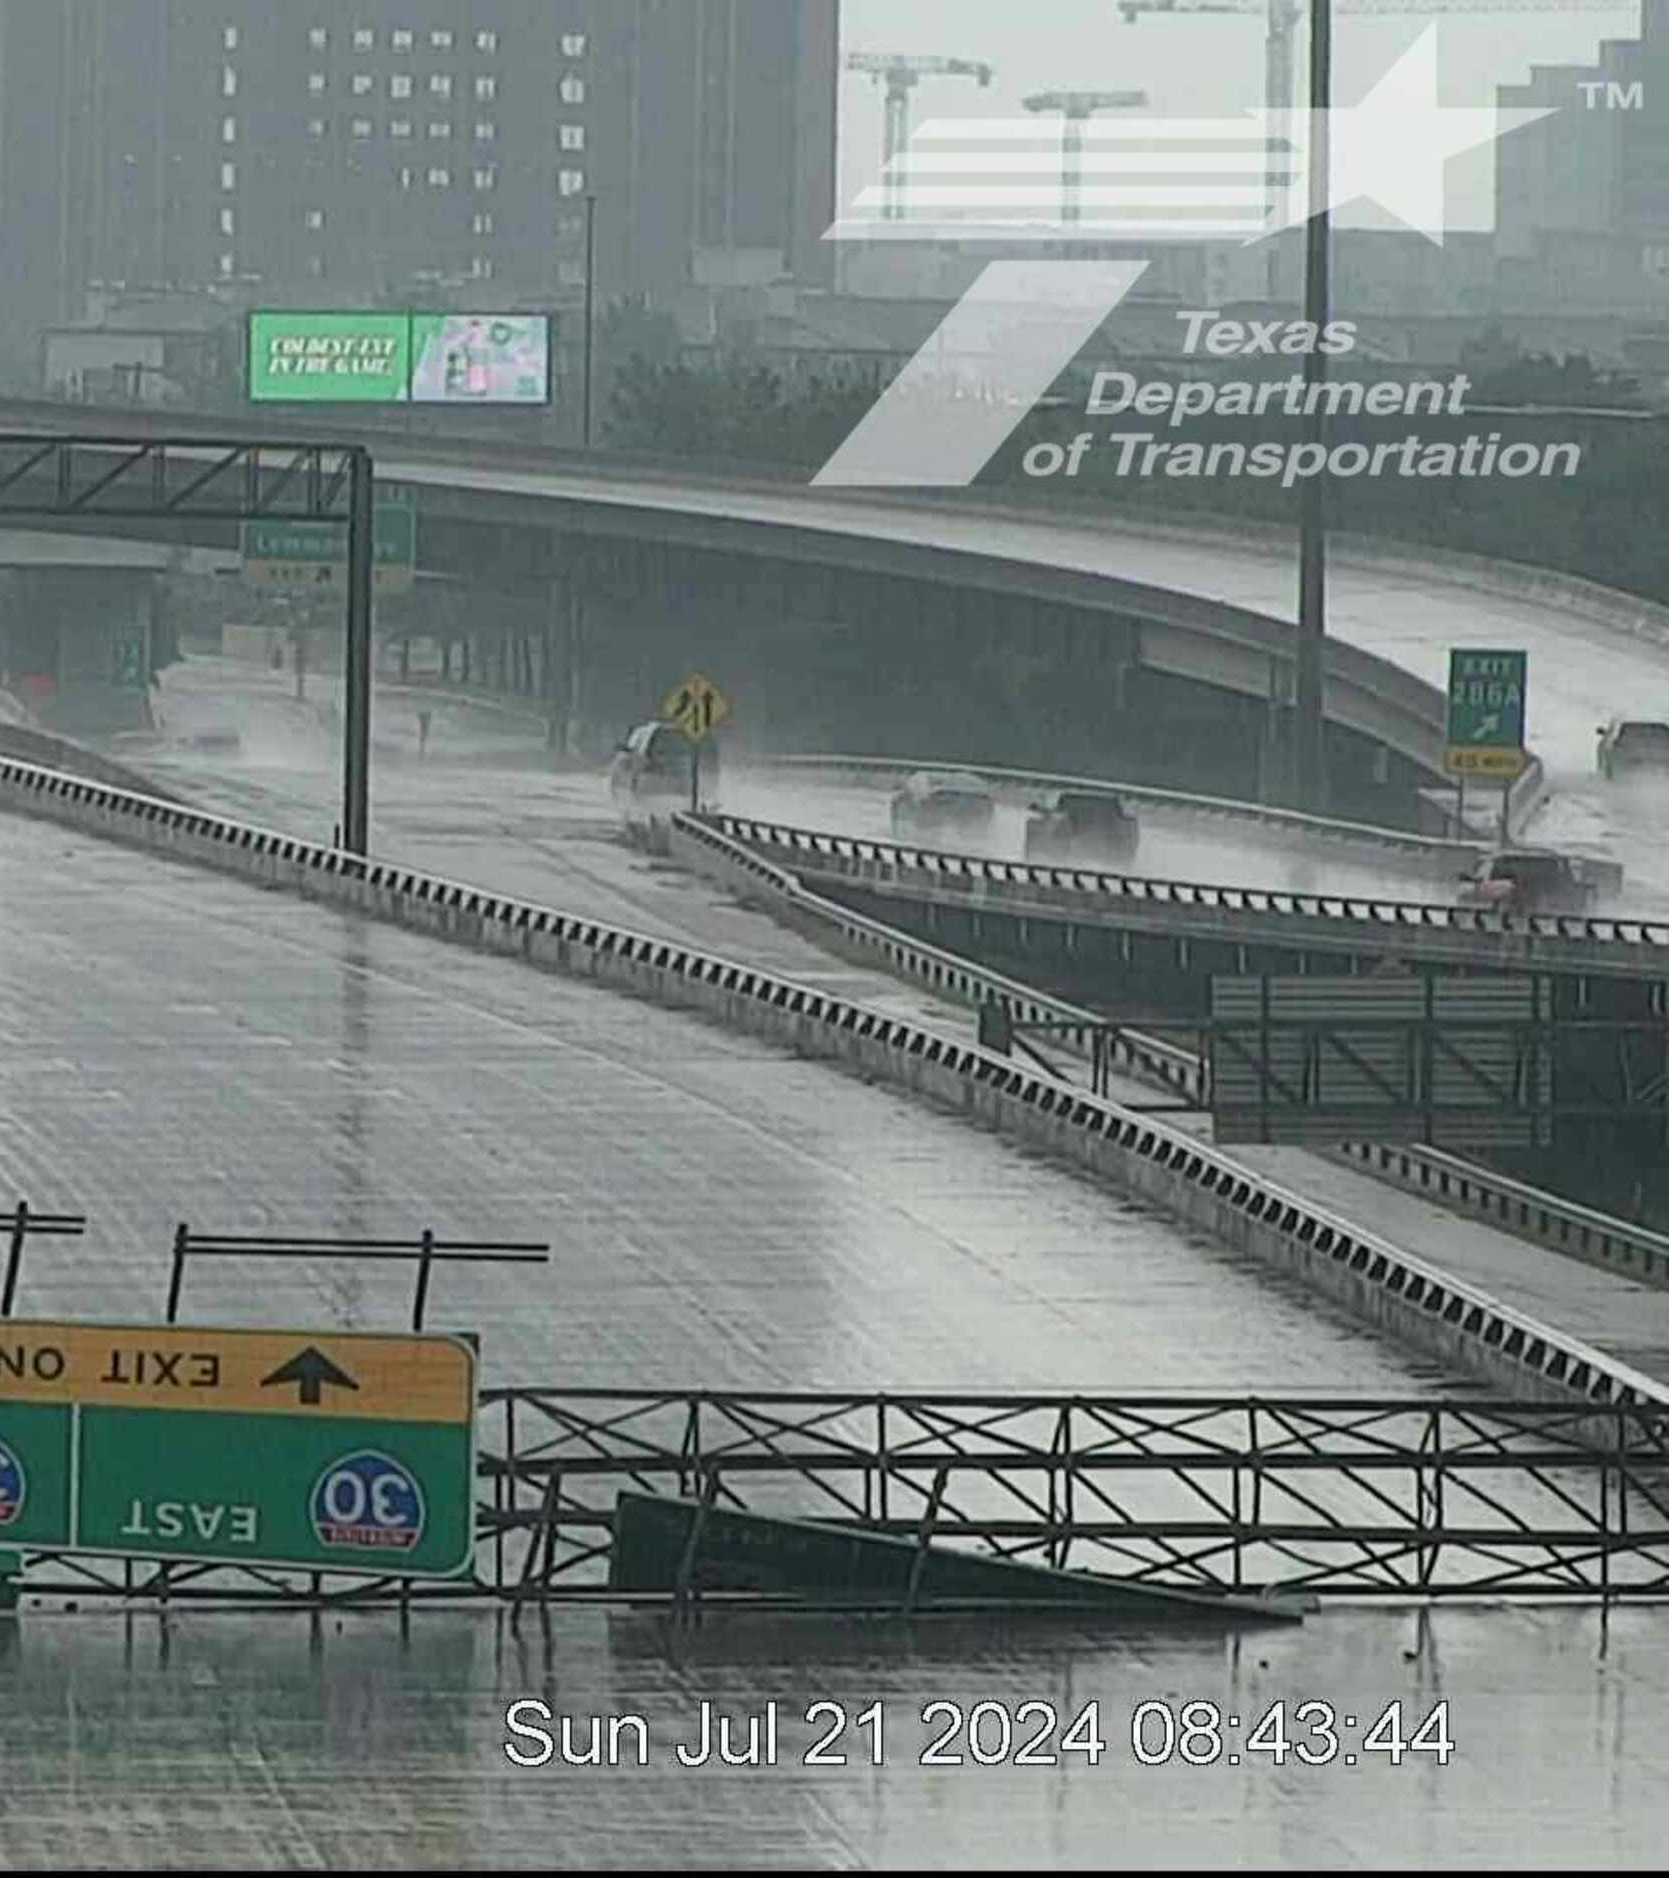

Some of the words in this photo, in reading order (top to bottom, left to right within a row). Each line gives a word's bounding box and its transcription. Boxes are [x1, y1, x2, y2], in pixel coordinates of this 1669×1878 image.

[1463, 657, 1511, 674] EXIT
[99, 1351, 220, 1388] EXIT
[324, 1469, 409, 1526] 30
[121, 1501, 258, 1544] EAST
